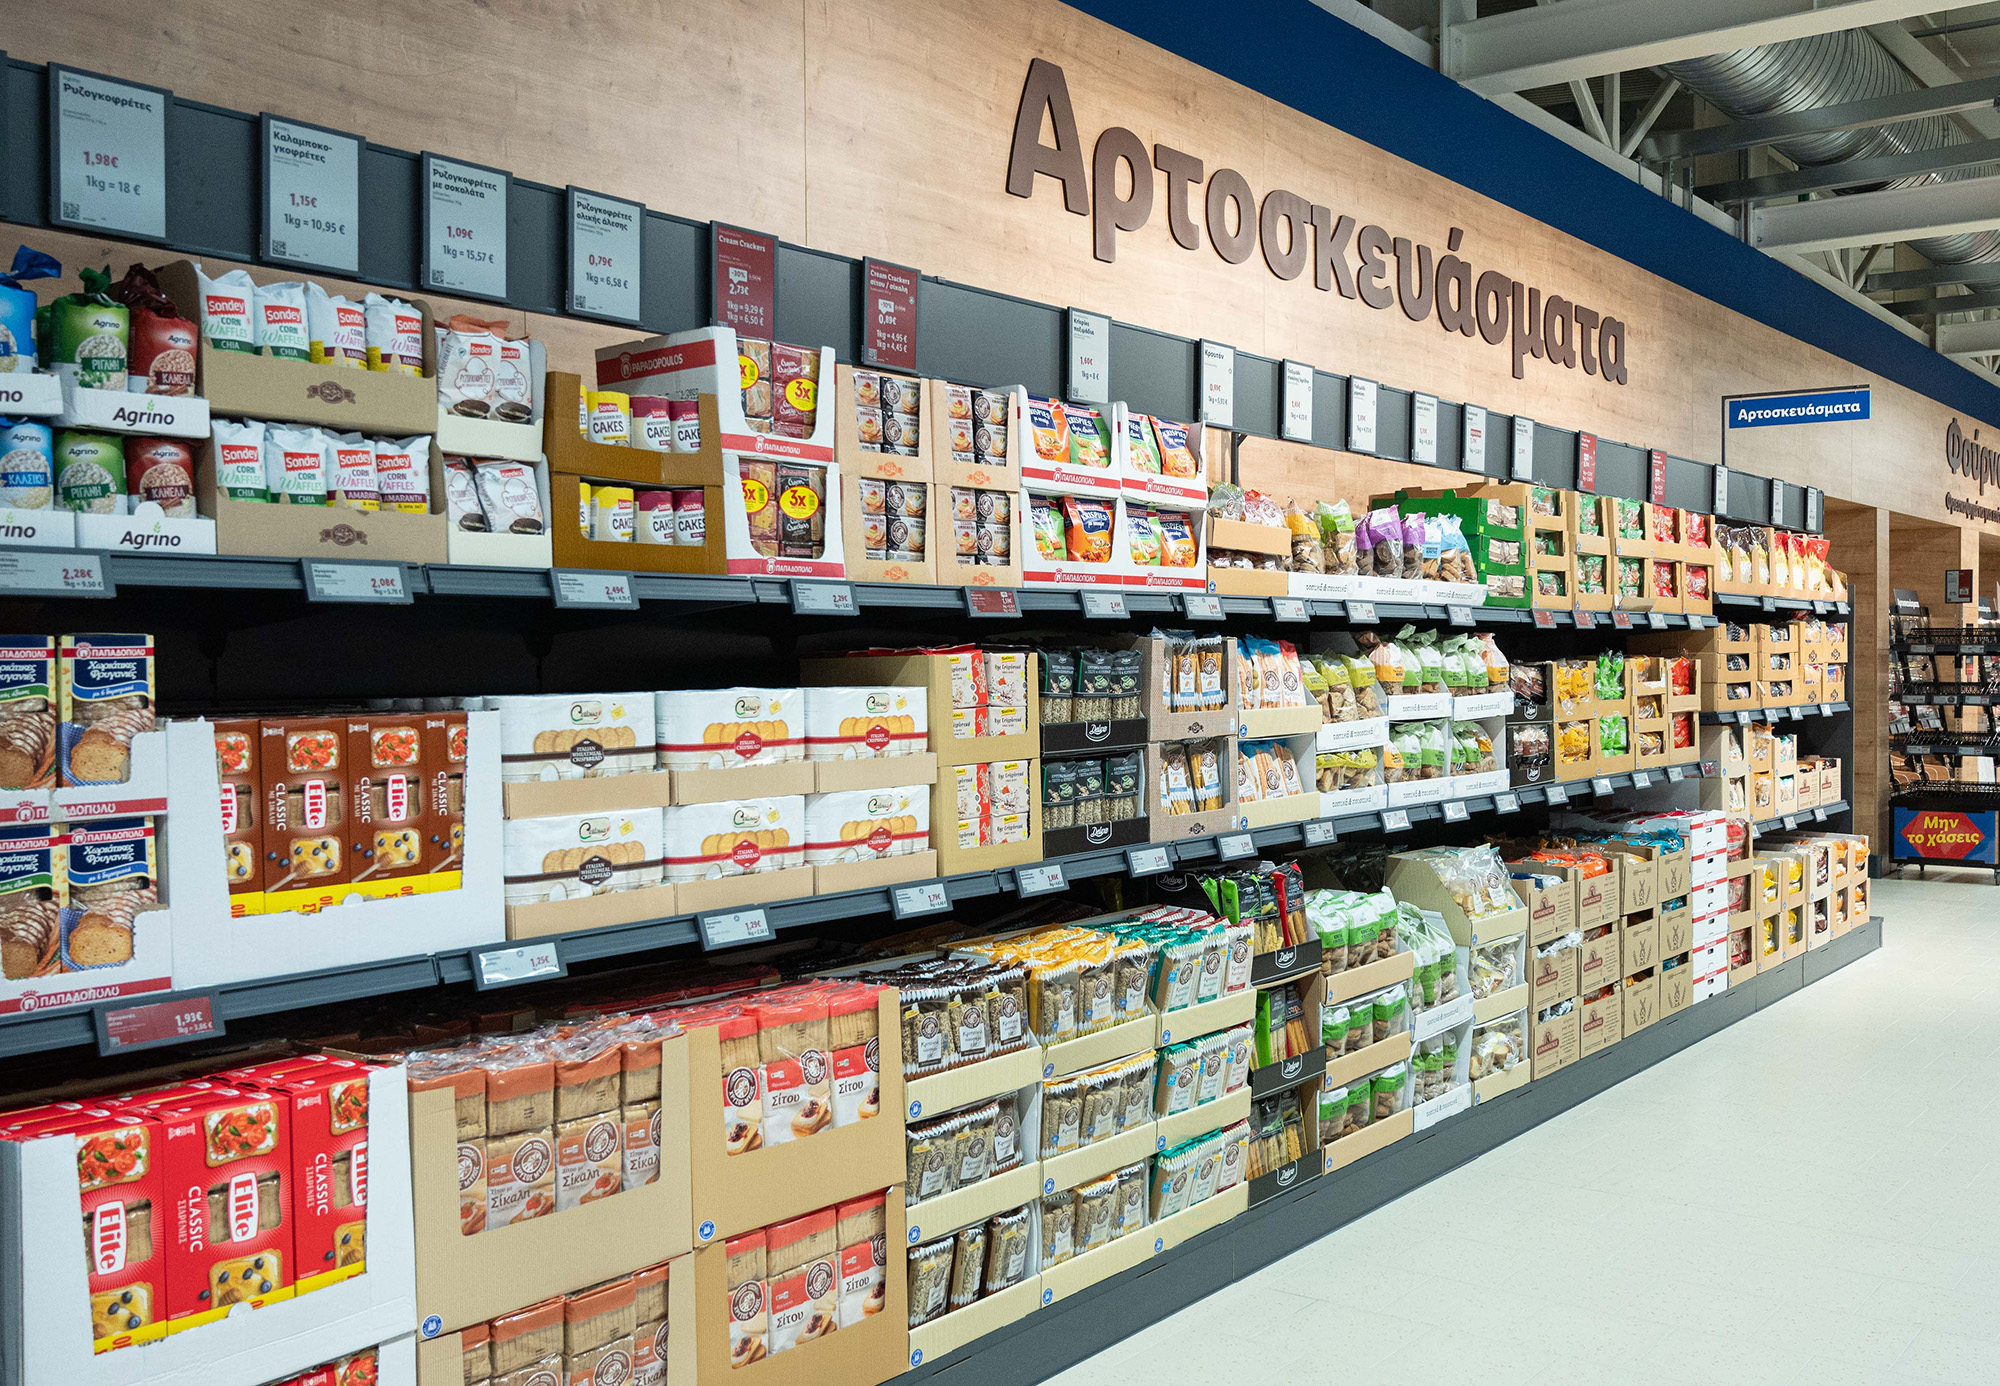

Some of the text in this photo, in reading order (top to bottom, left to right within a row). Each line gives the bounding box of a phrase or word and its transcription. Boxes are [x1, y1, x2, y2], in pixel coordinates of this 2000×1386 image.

[63, 83, 152, 113] Ρυζογκοφρέτες
[83, 151, 119, 168] 1,98€
[273, 144, 326, 164] γκοφρέτες
[85, 175, 141, 196] 1kg 18 €
[432, 168, 497, 191] Ρυζογκοφρέτες
[432, 182, 443, 190] με
[444, 183, 485, 199] σοκολάτα
[289, 193, 318, 208] 1,15€
[284, 213, 346, 235] 1kg 10,95 €
[1005, 57, 1628, 386] Αρτοσκευάσματα
[447, 226, 473, 240] 1,09€
[719, 234, 766, 253] Cream Crackers
[443, 245, 495, 264] 1kg 15,57 €
[589, 254, 613, 268] 0,79€
[586, 272, 628, 289] 1kg 6,58 €
[729, 283, 749, 296] 2,73€
[208, 300, 244, 312] Sondey
[727, 300, 738, 313] 1kg
[221, 317, 241, 326] CORN
[266, 310, 300, 321] Sondey
[727, 311, 738, 324] 1kg
[93, 319, 120, 329] Agrino
[279, 325, 298, 334] CORN
[168, 334, 193, 345] Agrino
[221, 340, 240, 350] CHIA
[280, 347, 298, 357] CHIA
[471, 346, 491, 355] Sondey
[91, 359, 120, 371] ΡΙΓΑΝΗ
[632, 354, 684, 371] PAPADOPOULOS
[795, 381, 810, 400] 3x
[113, 407, 175, 426] Agrino
[1738, 402, 1860, 422] Αρτοσκευάσματα
[593, 421, 624, 434] CAKES
[12, 433, 42, 443] Agrino
[678, 430, 700, 441] CAKE
[68, 447, 98, 457] Agrino
[223, 448, 258, 462] Sondey
[286, 456, 320, 469] Sondey
[339, 453, 371, 466] Sondey
[377, 458, 410, 469] Sondey
[236, 465, 255, 474] CORN
[298, 472, 316, 480] CORN
[352, 469, 369, 477] CORN
[8, 473, 45, 485] ΚΛΑΣΙΚΗ
[70, 485, 101, 498] ΡΙΓΑΝΗ
[151, 487, 186, 499] ΚΑΝΕΛΑ
[237, 489, 255, 497] CHIA
[790, 490, 806, 507] 3x
[298, 495, 315, 504] CHIA
[120, 531, 182, 549] Agrino
[62, 568, 93, 580] 2,28€
[371, 578, 395, 588] 2,08€
[605, 586, 624, 595] 2,49€
[87, 660, 137, 671] Χωριάτικες
[90, 670, 137, 680] Φρυγανιές
[360, 776, 371, 824] CLASSIC
[391, 778, 405, 819] Elite
[438, 771, 448, 816] CLASSIC
[275, 782, 287, 832] CLASSIC
[307, 783, 322, 826] Elite
[1923, 816, 1959, 832] Μην
[1907, 831, 1980, 847] το χάσεις
[83, 844, 135, 855] Χωριάτικες
[86, 852, 135, 864] Φρυγανιές
[745, 920, 761, 930] 1,29€
[530, 955, 550, 967] 1,25€
[175, 1012, 203, 1026] 1,93€
[838, 1081, 864, 1094] Σίτου
[771, 1093, 800, 1107] Σίτου
[630, 1153, 660, 1171] Σίκαλ
[315, 1152, 330, 1217] CLASSIC
[562, 1169, 600, 1188] Σίκαλη
[491, 1190, 531, 1209] Σίκαλη
[234, 1178, 254, 1238] Elite
[188, 1185, 204, 1253] CLASSIC
[98, 1206, 122, 1271] Elite
[845, 1276, 870, 1292] Σίτου
[776, 1311, 804, 1329] Σίτου
[635, 1367, 668, 1386] Σίκαλ
